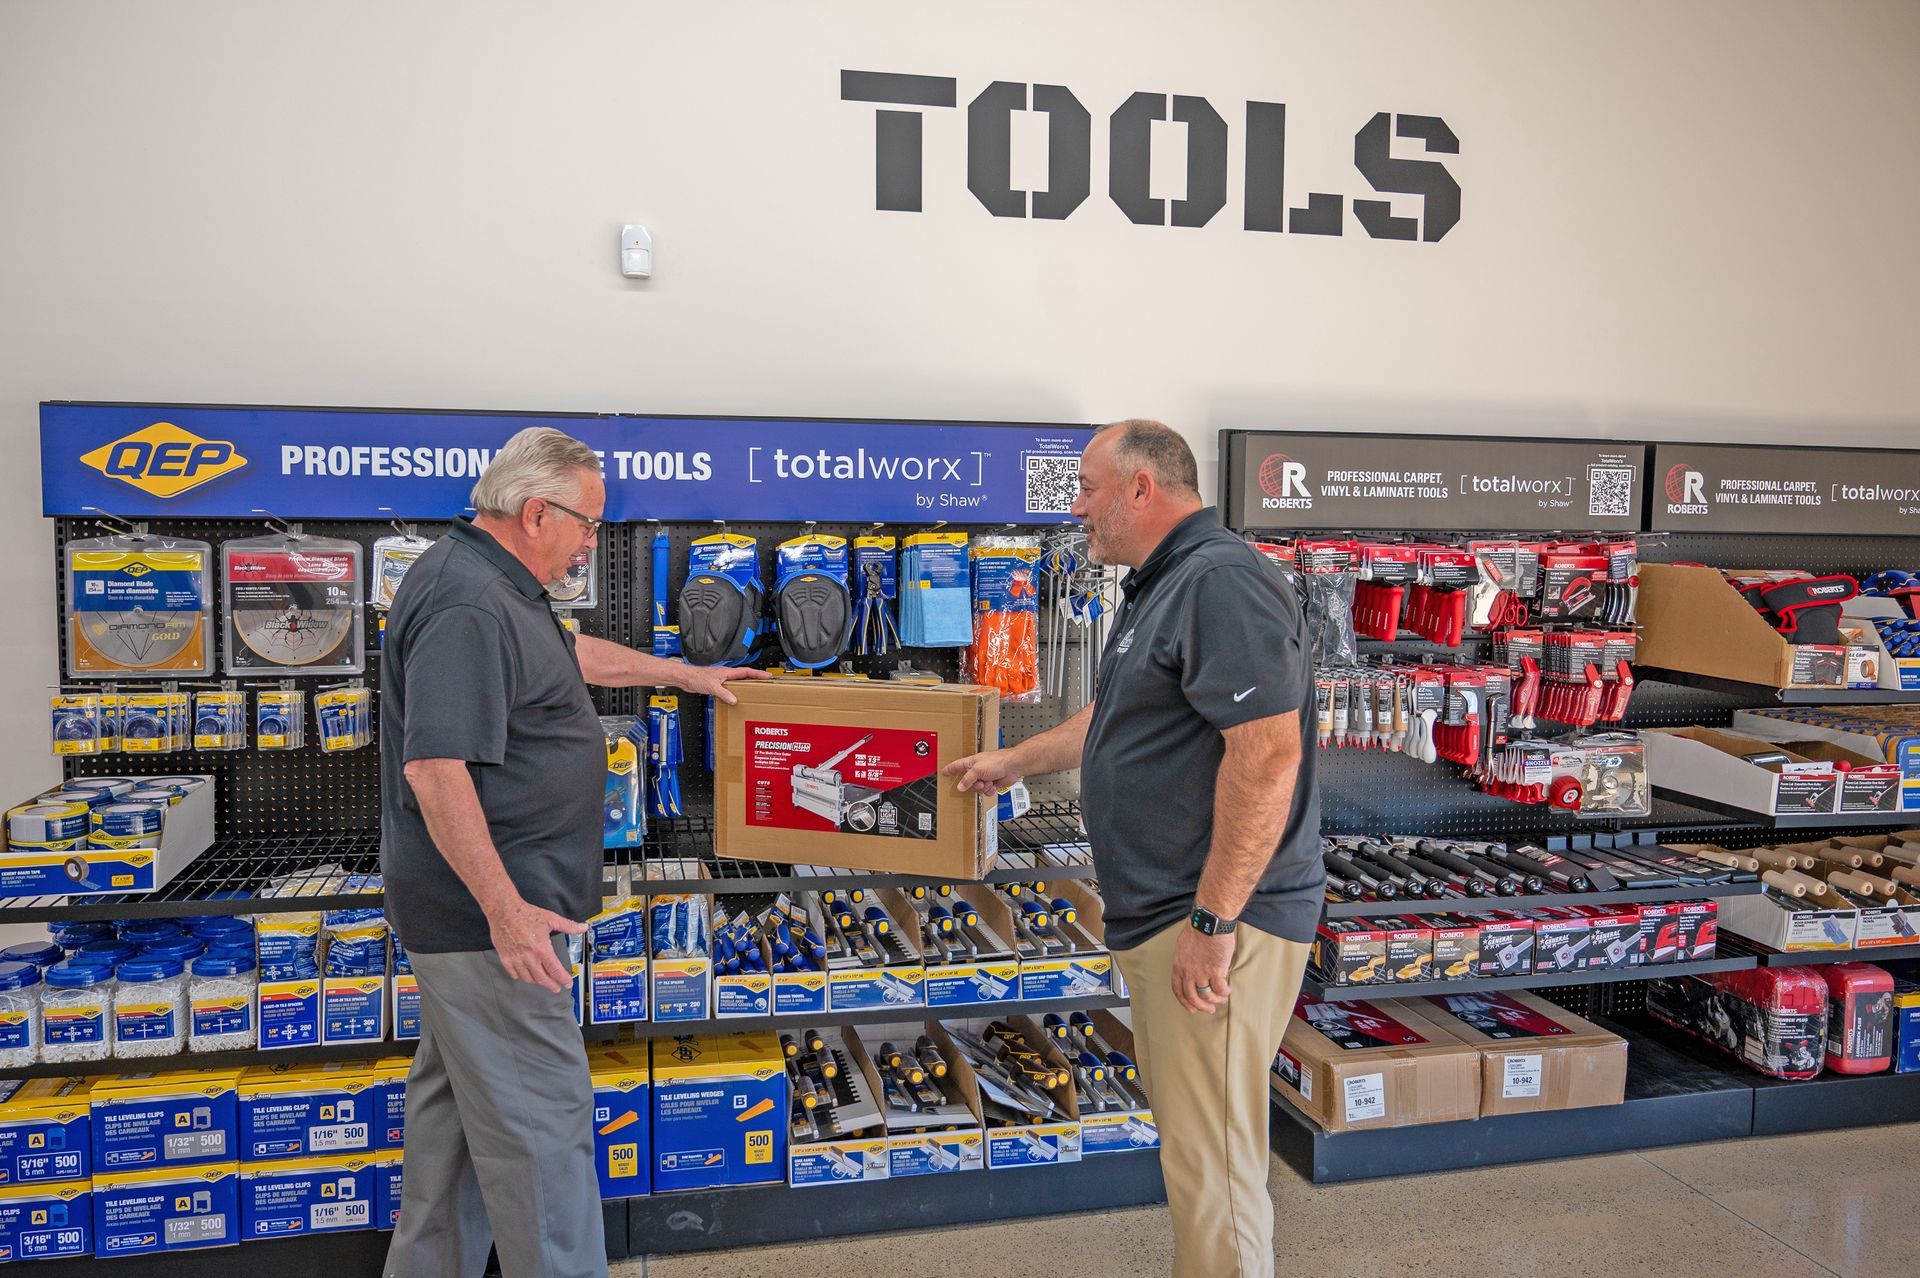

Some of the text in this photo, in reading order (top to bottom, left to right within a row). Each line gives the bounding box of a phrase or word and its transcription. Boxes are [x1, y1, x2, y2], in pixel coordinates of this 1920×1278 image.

[841, 69, 1461, 243] TOOLS
[106, 441, 231, 477] QEP
[281, 445, 502, 478] PROFESSION
[613, 451, 712, 481] TOOLS
[774, 448, 962, 481] totalworx
[1327, 470, 1443, 485] PROFESSIONAL CARPET,
[1472, 475, 1560, 494] totalworx
[1720, 479, 1817, 493] PROFESSIONAL CARPET,
[1320, 485, 1448, 499] VINYL & LAMINATE TOOLS
[1841, 484, 1919, 501] totalworx
[916, 494, 936, 508] by
[1262, 497, 1313, 509] ROBERTS
[1538, 500, 1547, 509] by
[1715, 493, 1821, 506] VINYL & LAMINATE TOOLS
[1667, 503, 1708, 515] ROBERTS
[1909, 506, 1920, 514] Sha
[327, 586, 339, 596] 10
[1811, 584, 1845, 595] ROBERTS
[265, 621, 328, 629] Black Widow
[152, 632, 180, 641] GOLD
[754, 727, 789, 736] ROBERTS
[755, 741, 793, 750] PRECISION
[1545, 934, 1570, 944] GENERAL
[1595, 929, 1621, 940] GENERAL
[1488, 935, 1513, 946] GENERAL
[361, 983, 378, 991] QEP
[1512, 1077, 1533, 1085] 10-942
[673, 1092, 699, 1100] LEVELING
[700, 1090, 724, 1098] WEDGES
[1355, 1096, 1375, 1106] 10-942
[266, 1105, 293, 1113] LEVELING
[322, 1109, 332, 1117] A
[119, 1113, 147, 1122] LEVELING
[147, 1111, 164, 1119] CLIPS
[177, 1115, 188, 1124] A
[133, 1119, 161, 1128] NIVELAGE
[266, 1119, 296, 1127] CARREAUX
[118, 1127, 150, 1135] CARREAUX
[344, 1127, 364, 1138] 500
[31, 1137, 42, 1146] A
[200, 1134, 222, 1146] 500
[749, 1135, 769, 1146] 500
[612, 1147, 634, 1160] 500
[55, 1156, 78, 1168] 500
[204, 1170, 224, 1178] QEP
[59, 1188, 77, 1196] QEP
[281, 1189, 308, 1197] NIVELAGE
[323, 1186, 333, 1194] A
[119, 1197, 147, 1206] LEVELING
[178, 1200, 188, 1208] A
[3, 1208, 20, 1216] CLIPS
[133, 1204, 161, 1212] NIVELAGE
[345, 1205, 365, 1216] 500
[34, 1213, 44, 1222] A
[119, 1211, 150, 1220] CARREAUX
[201, 1218, 222, 1230] 500
[57, 1232, 79, 1244] 500
